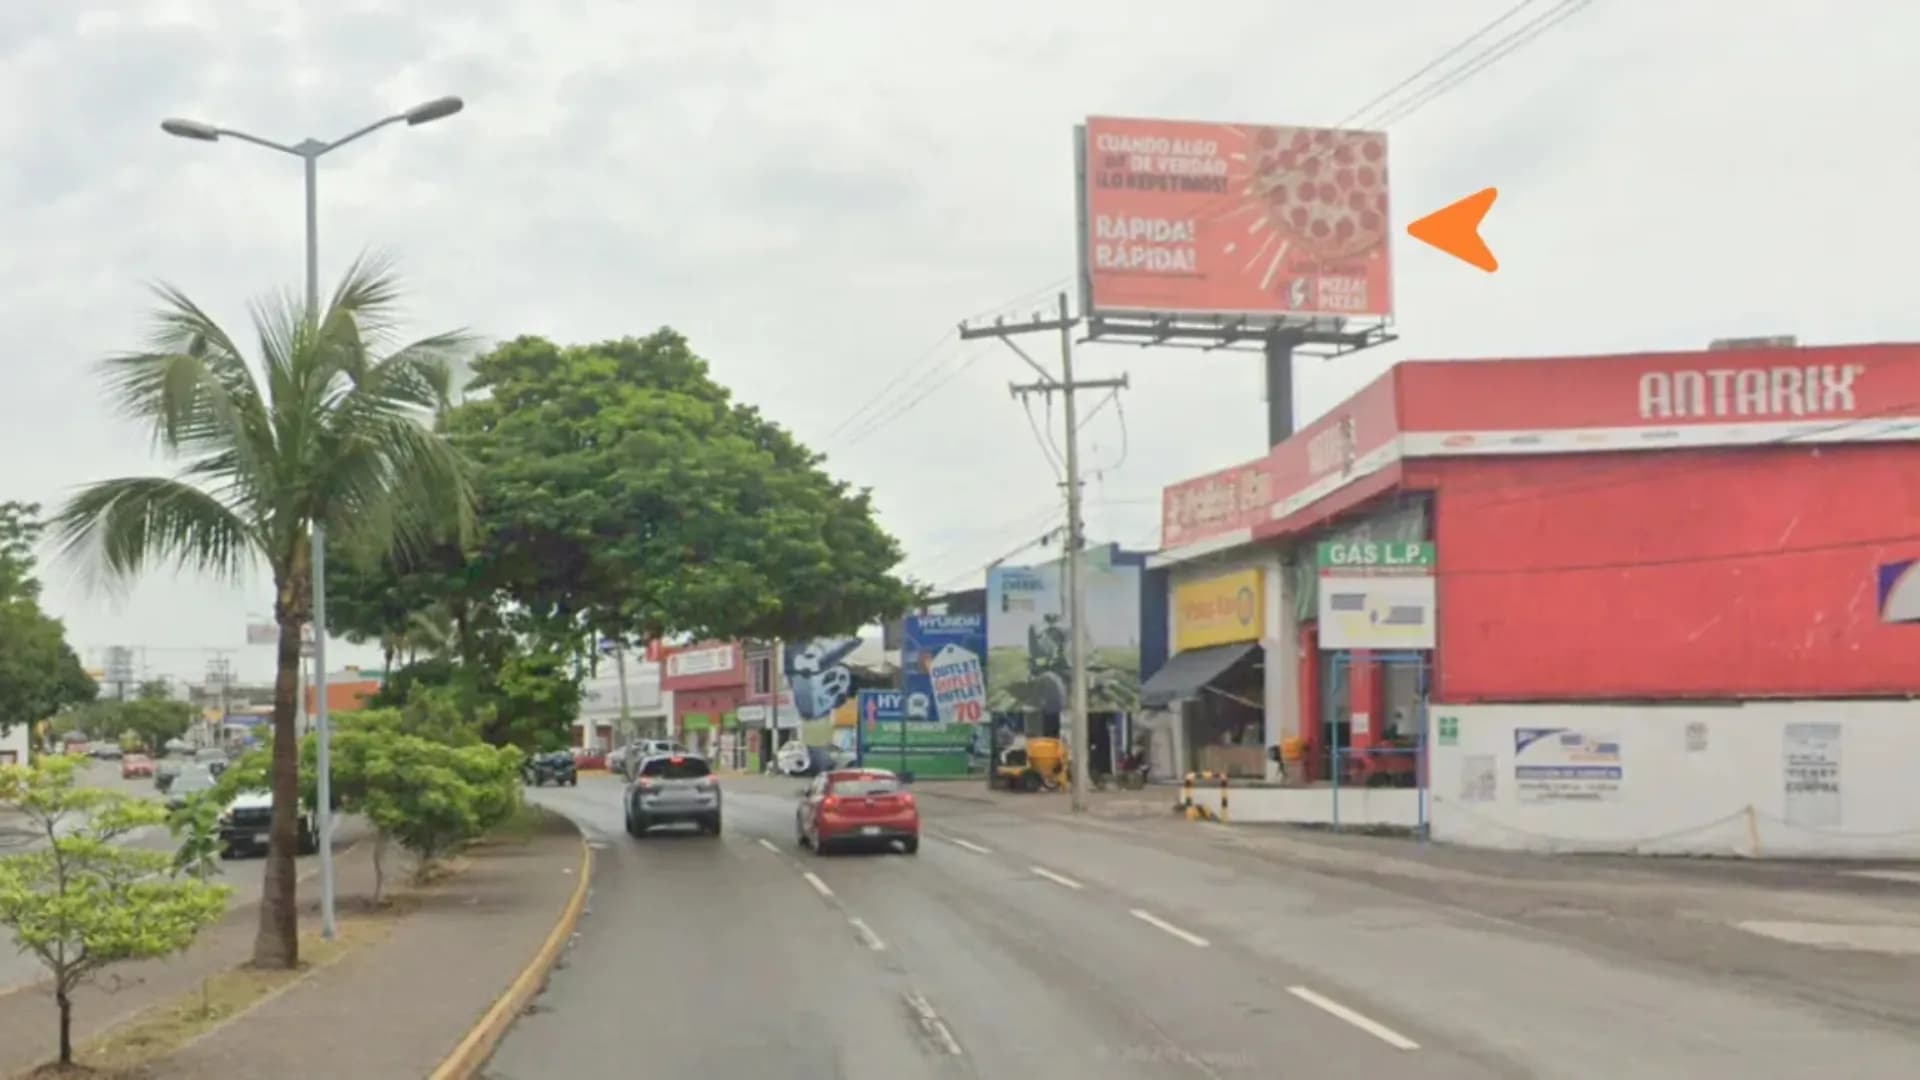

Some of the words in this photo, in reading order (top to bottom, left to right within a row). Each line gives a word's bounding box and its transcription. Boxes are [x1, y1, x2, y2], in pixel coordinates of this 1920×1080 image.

[1097, 134, 1169, 153] CUANDO
[1171, 139, 1218, 156] ALGO
[1096, 213, 1195, 243] RÁPIDA!
[1096, 242, 1196, 271] RÁPIDA!
[1639, 364, 1856, 419] ANTARIX
[1330, 543, 1379, 565] GAS
[1385, 543, 1428, 564] L.P.
[917, 615, 980, 628] HYUNDAI
[932, 660, 978, 678] OUTLET
[937, 684, 983, 704] OUTLET
[954, 700, 981, 724] 70
